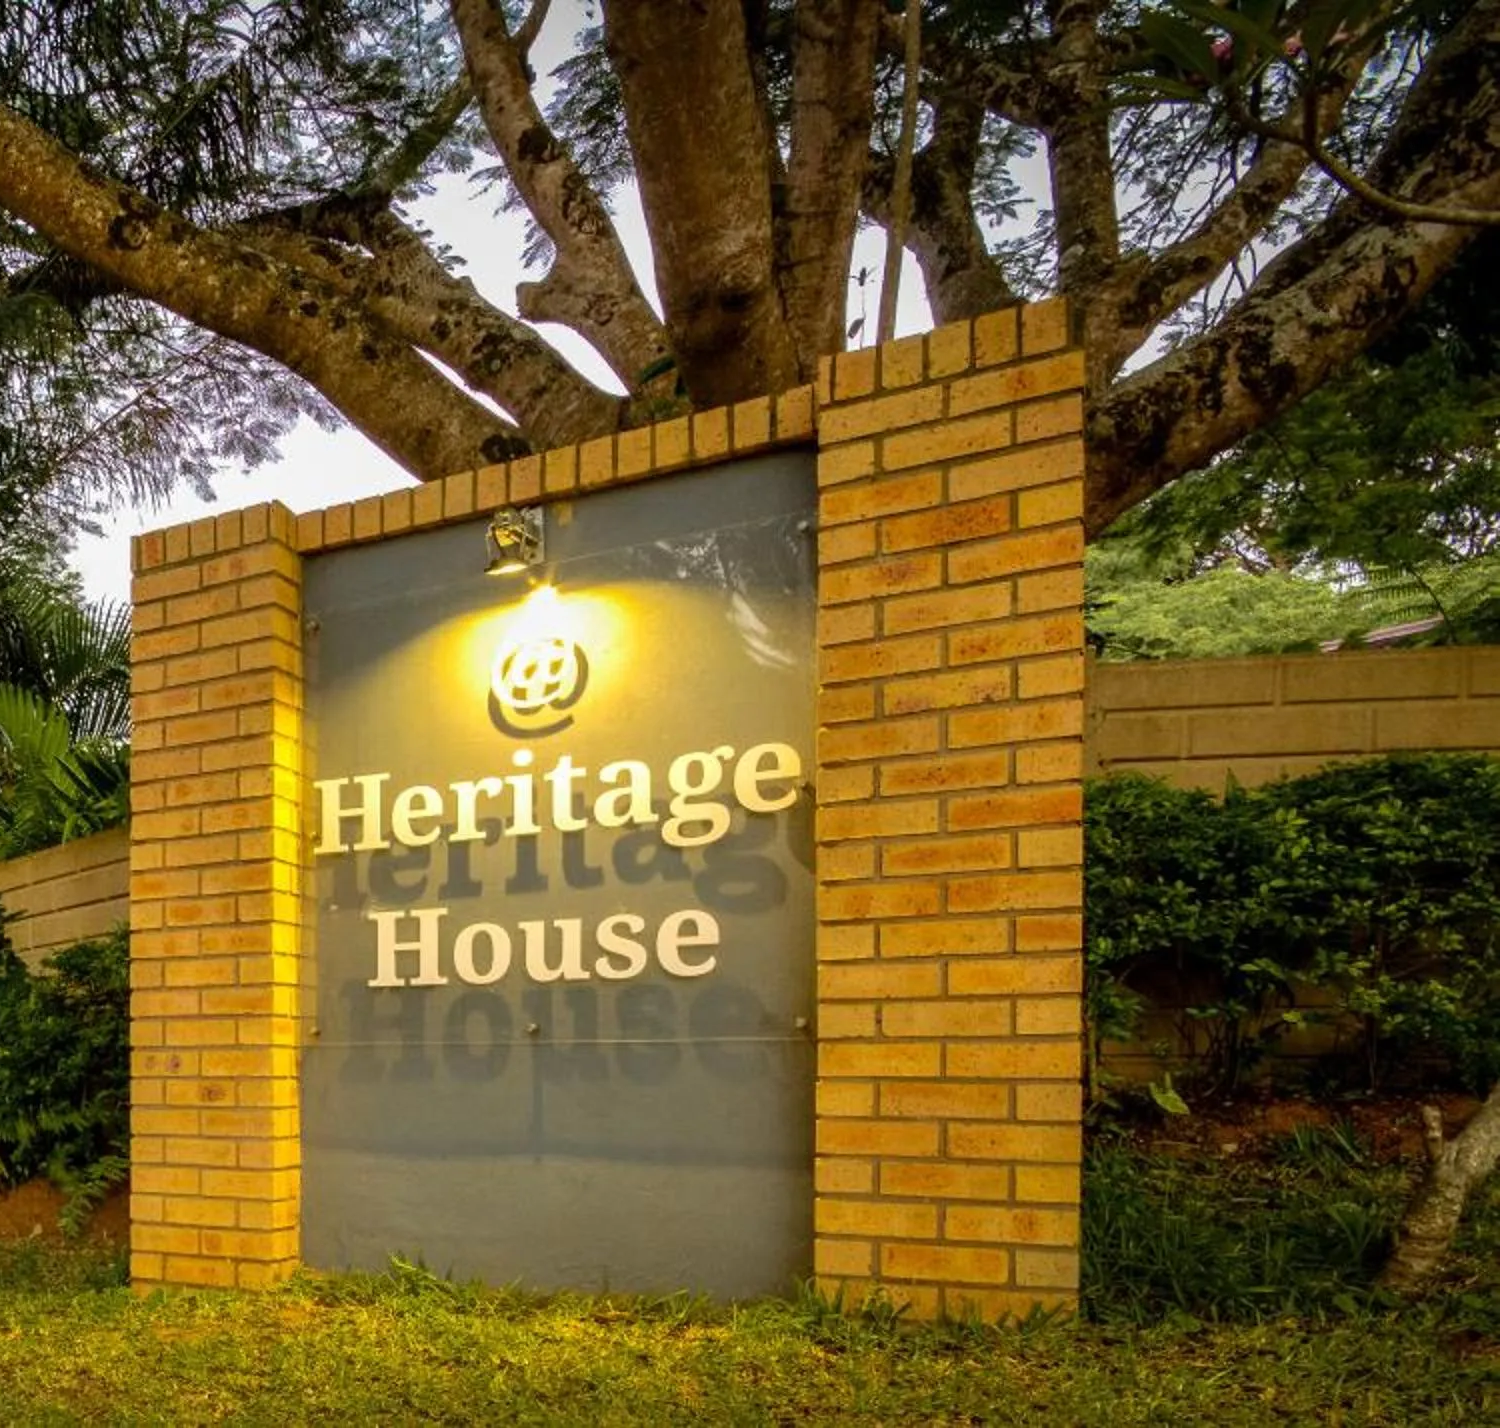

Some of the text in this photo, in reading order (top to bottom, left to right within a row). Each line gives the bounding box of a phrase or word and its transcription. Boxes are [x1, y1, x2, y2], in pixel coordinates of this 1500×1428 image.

[491, 634, 579, 709] @
[312, 740, 802, 856] Heritage
[367, 906, 721, 987] House
